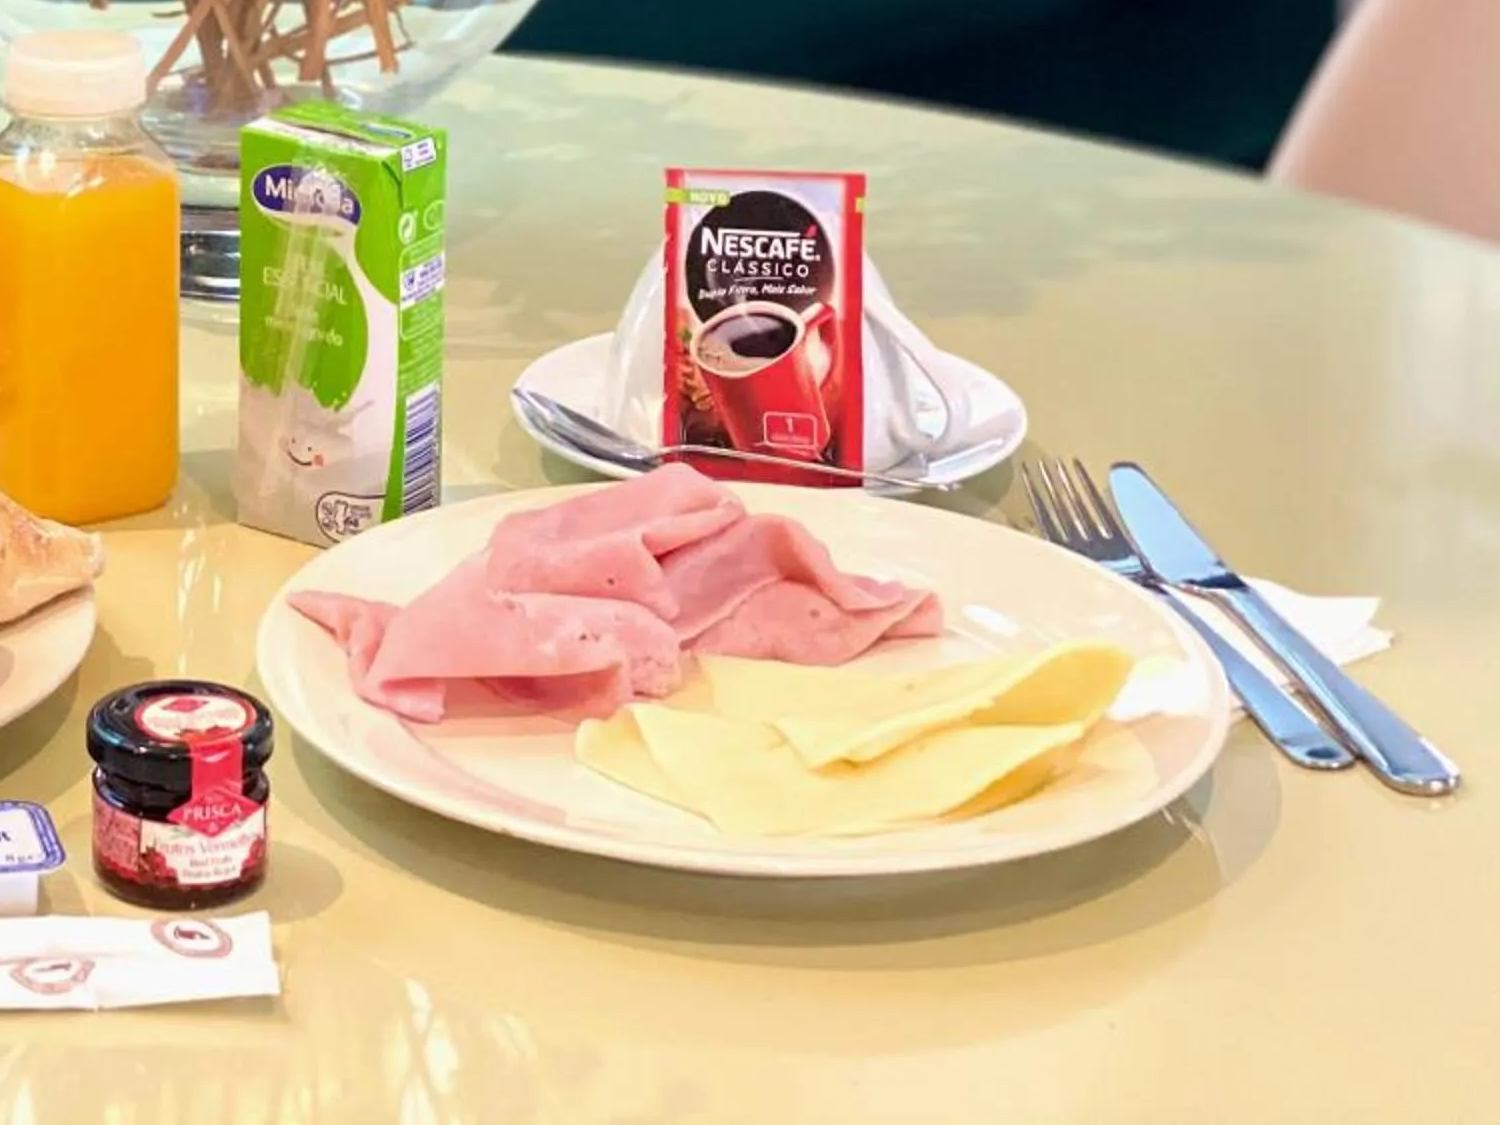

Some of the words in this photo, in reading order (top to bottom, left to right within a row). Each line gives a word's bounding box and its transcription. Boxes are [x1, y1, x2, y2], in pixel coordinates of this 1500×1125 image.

[264, 175, 355, 215] Mioa
[707, 259, 810, 278] CLÁSSICO
[183, 804, 242, 821] PRISCA
